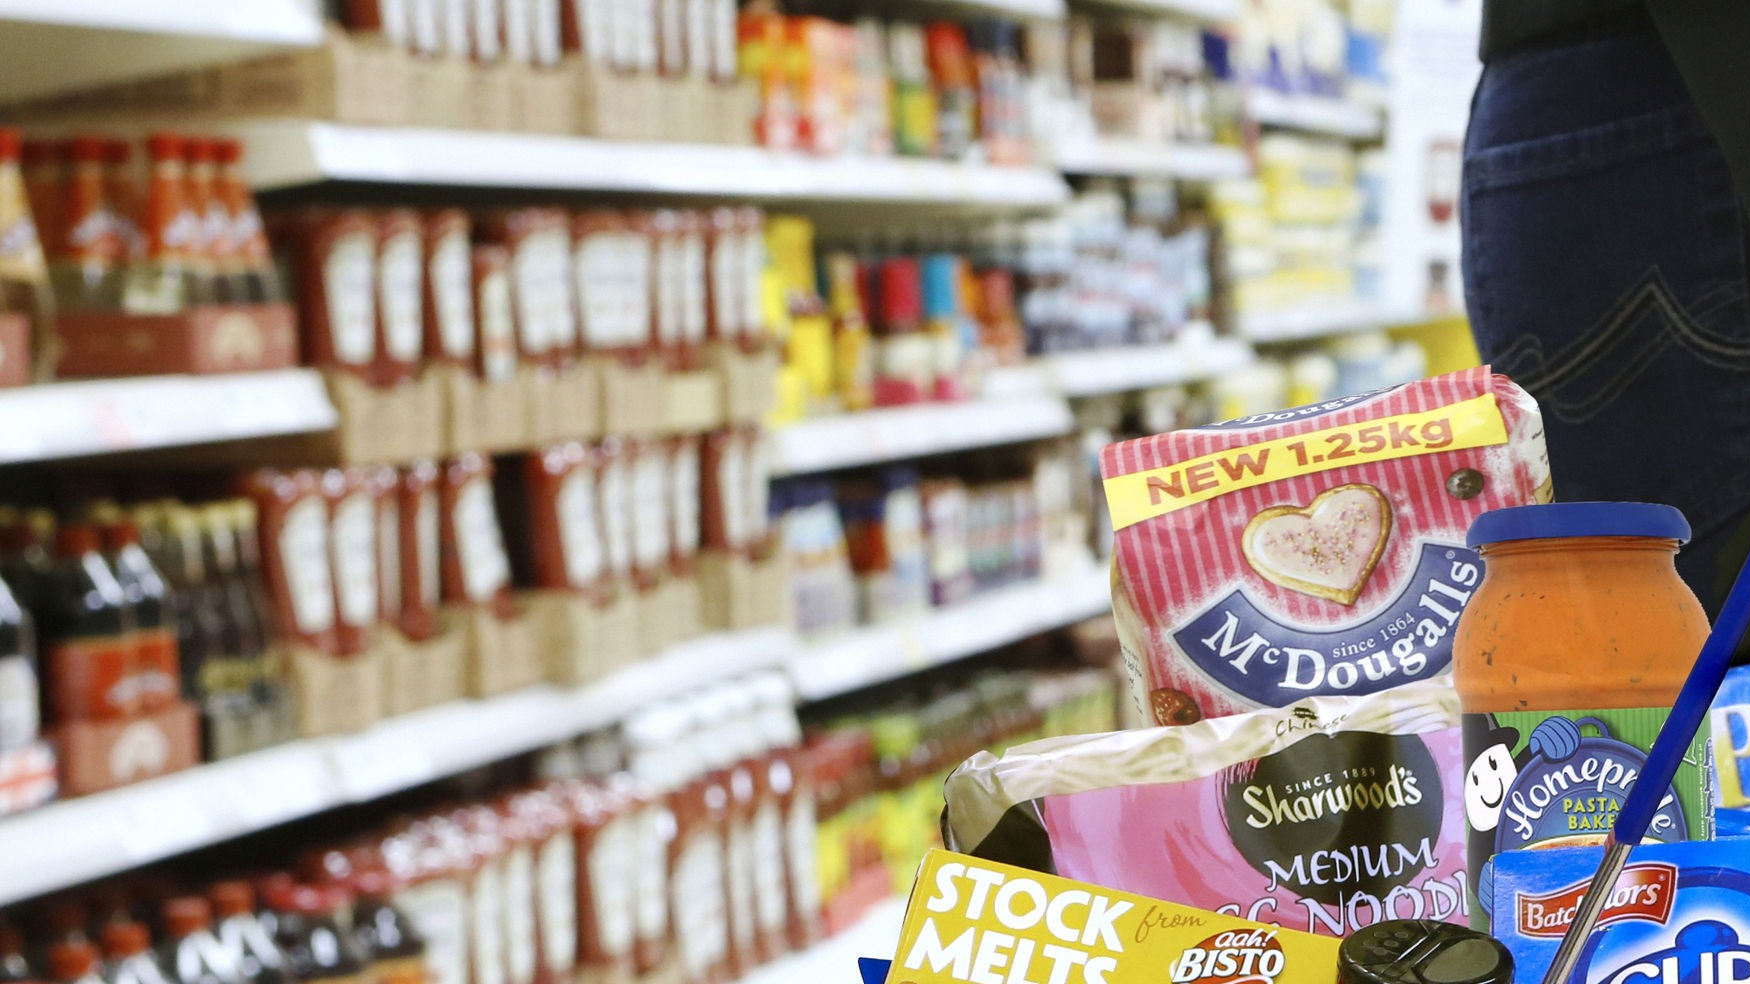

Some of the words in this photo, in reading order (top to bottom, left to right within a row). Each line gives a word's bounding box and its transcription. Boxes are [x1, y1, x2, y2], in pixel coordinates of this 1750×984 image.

[1146, 448, 1270, 505] NEW
[1287, 418, 1454, 466] 1.25kg
[1332, 638, 1376, 658] since
[1379, 612, 1415, 641] 1864
[1243, 764, 1422, 829] Sharwood's
[1286, 773, 1333, 794] SINCE
[1506, 757, 1672, 841] Homepre
[1563, 797, 1620, 814] PASTA
[1568, 815, 1616, 831] BAKE
[1264, 837, 1440, 892] MEDIUM
[926, 862, 1135, 953] STOCK
[1135, 905, 1206, 943] from
[1296, 870, 1470, 936] NOOD
[1527, 882, 1662, 931] Batclors
[1215, 929, 1278, 949] aah!
[1172, 948, 1285, 984] BISTO
